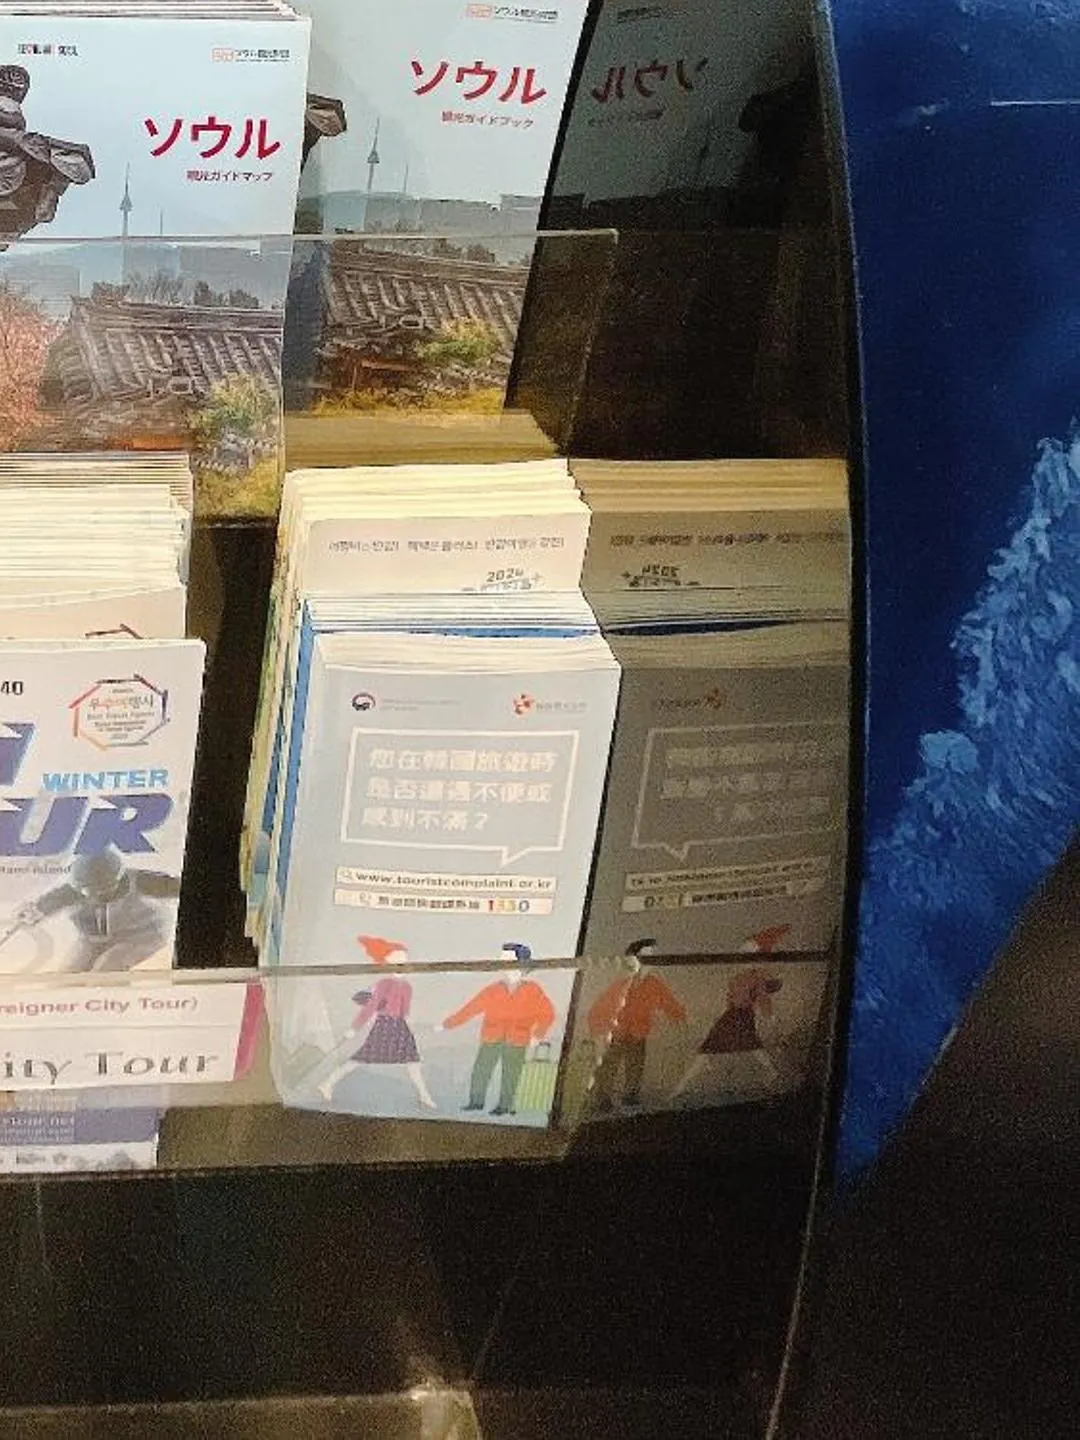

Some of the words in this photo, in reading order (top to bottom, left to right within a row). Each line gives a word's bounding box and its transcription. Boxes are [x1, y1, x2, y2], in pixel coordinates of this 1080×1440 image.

[410, 59, 548, 105] ソウル
[143, 115, 281, 161] ソウル
[42, 768, 170, 793] WINTER
[86, 998, 131, 1015] City
[139, 995, 198, 1013] Tour)
[84, 1050, 219, 1076] Tour
